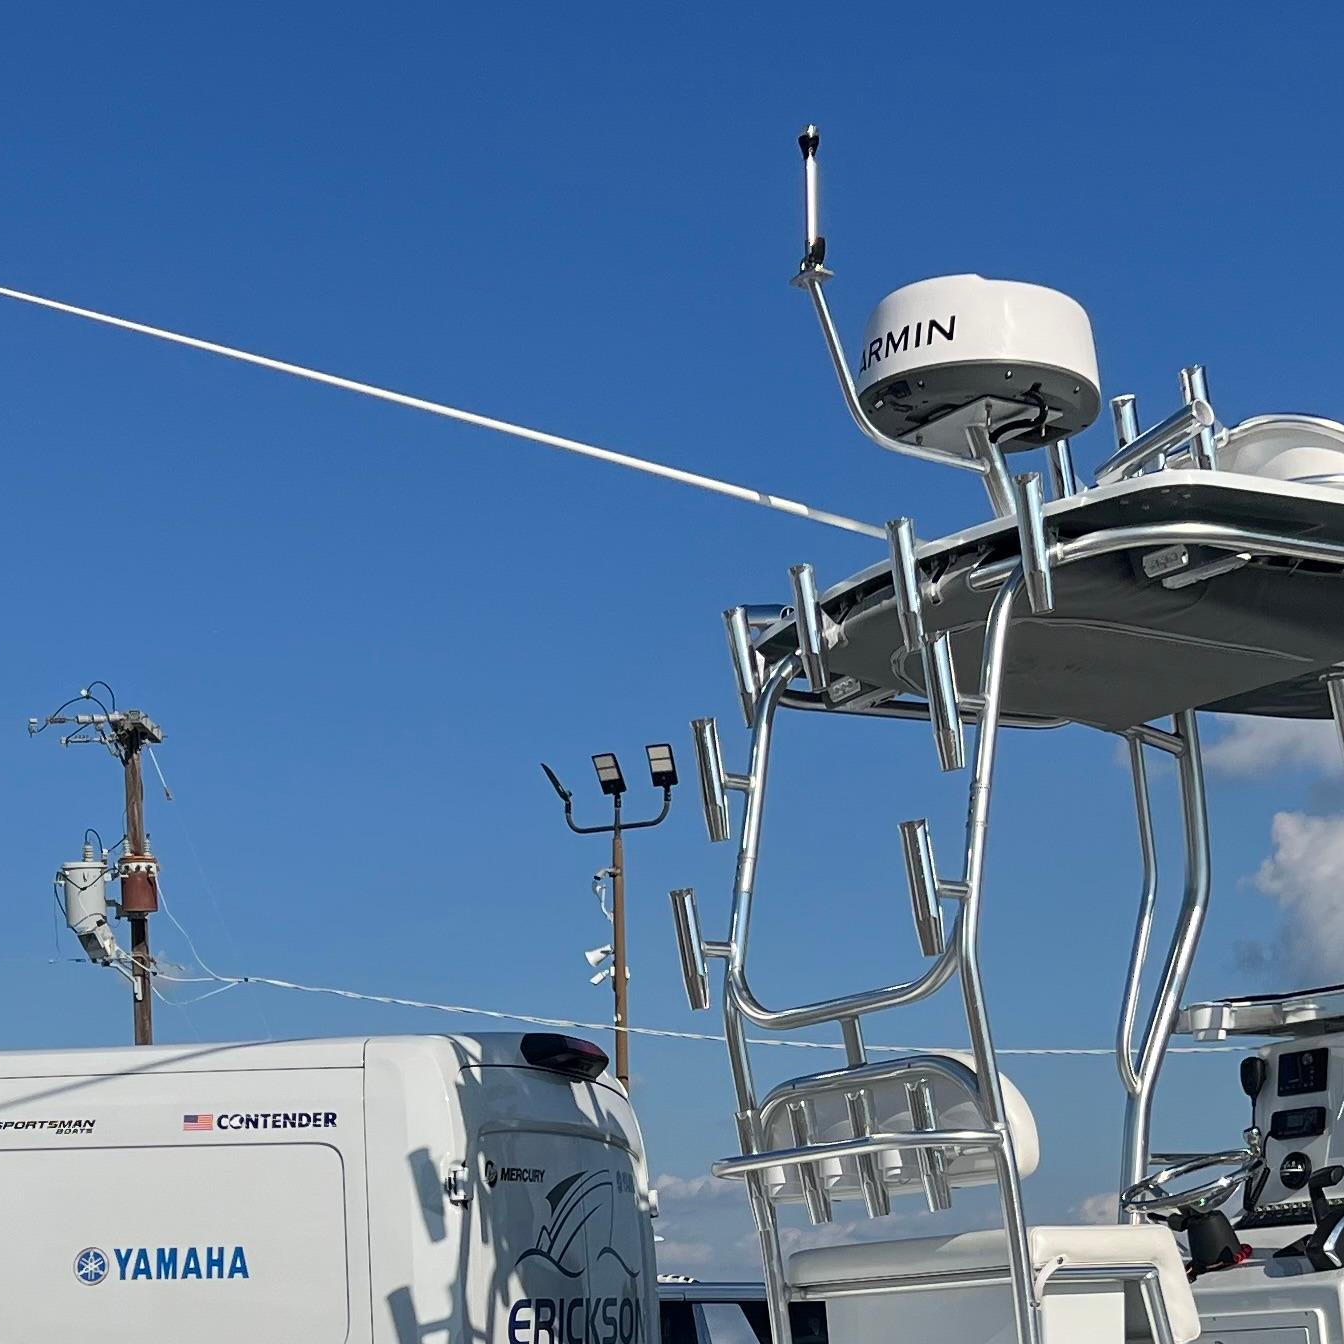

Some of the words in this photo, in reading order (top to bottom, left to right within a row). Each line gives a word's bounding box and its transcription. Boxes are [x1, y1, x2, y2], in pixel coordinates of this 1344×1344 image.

[858, 315, 956, 379] ARMIN
[217, 1112, 337, 1129] CONTENDER
[501, 1168, 545, 1183] MERCURY
[114, 1247, 250, 1280] YAMAHA
